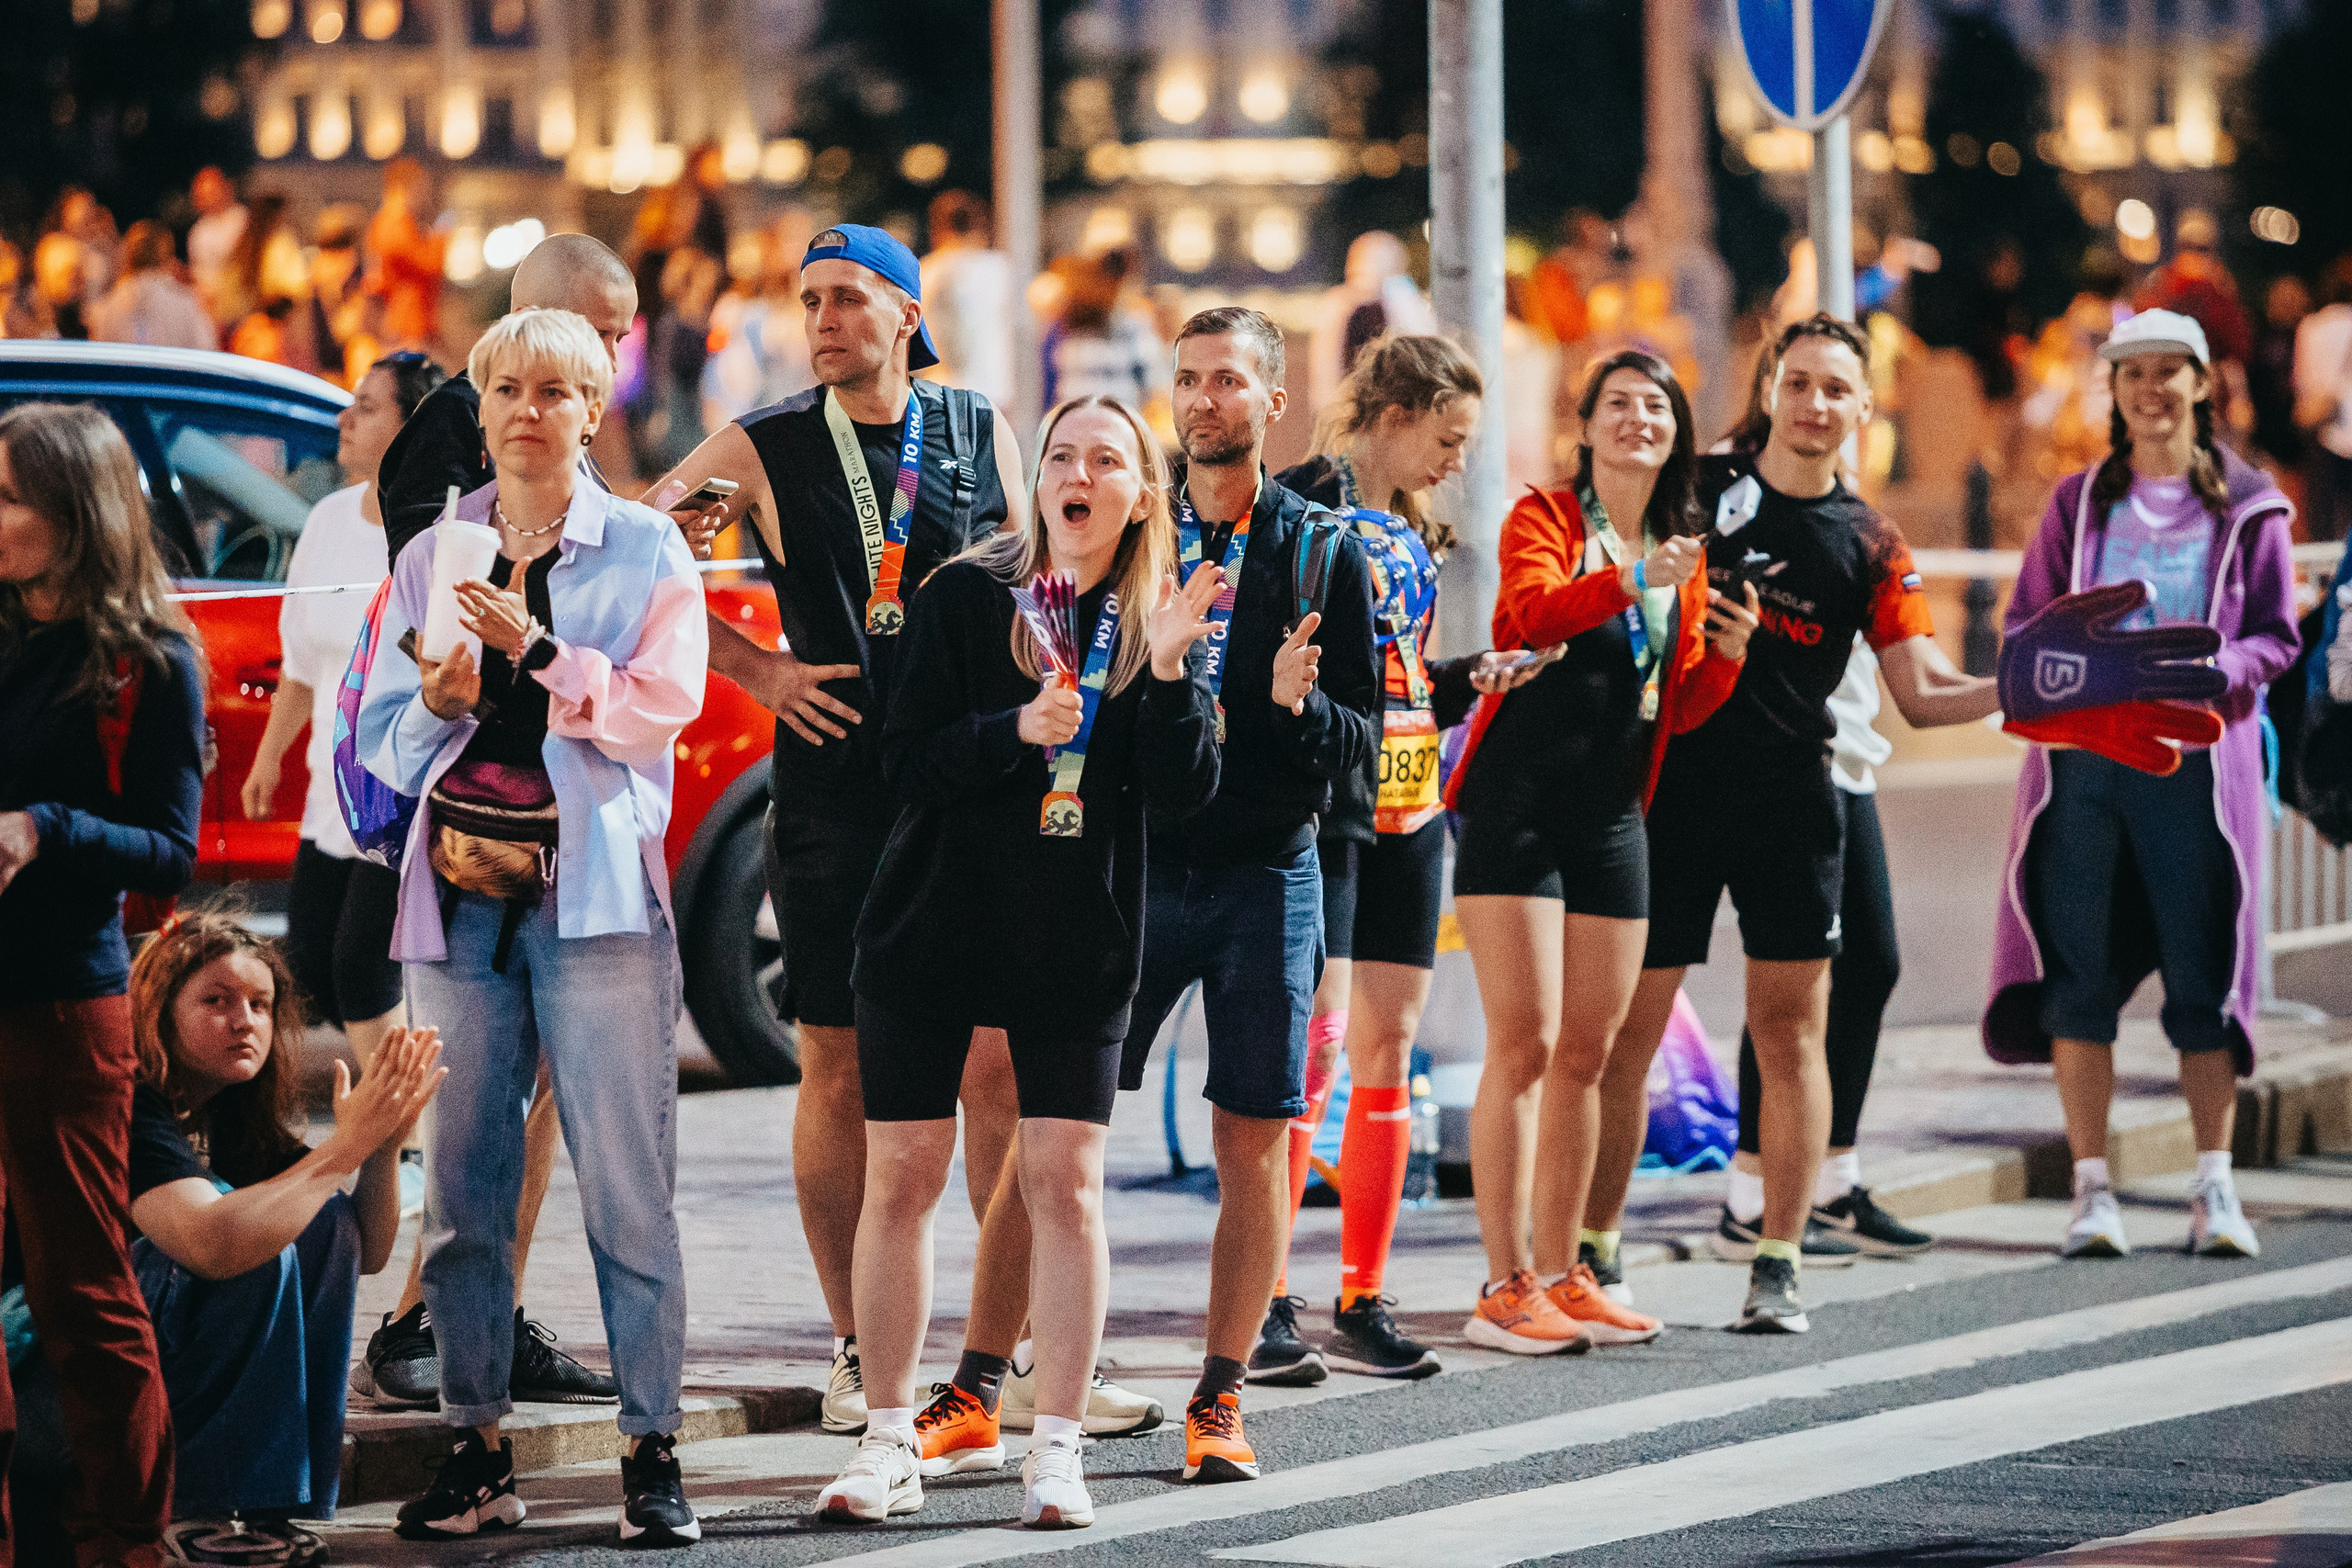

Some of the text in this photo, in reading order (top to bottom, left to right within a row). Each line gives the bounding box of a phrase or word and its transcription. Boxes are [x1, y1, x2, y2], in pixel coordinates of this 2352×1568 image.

[903, 412, 921, 463] 10 KM
[840, 431, 883, 587] ITE NIGHTS MARATHON
[1094, 618, 1114, 649] KM
[1205, 647, 1220, 675] KM
